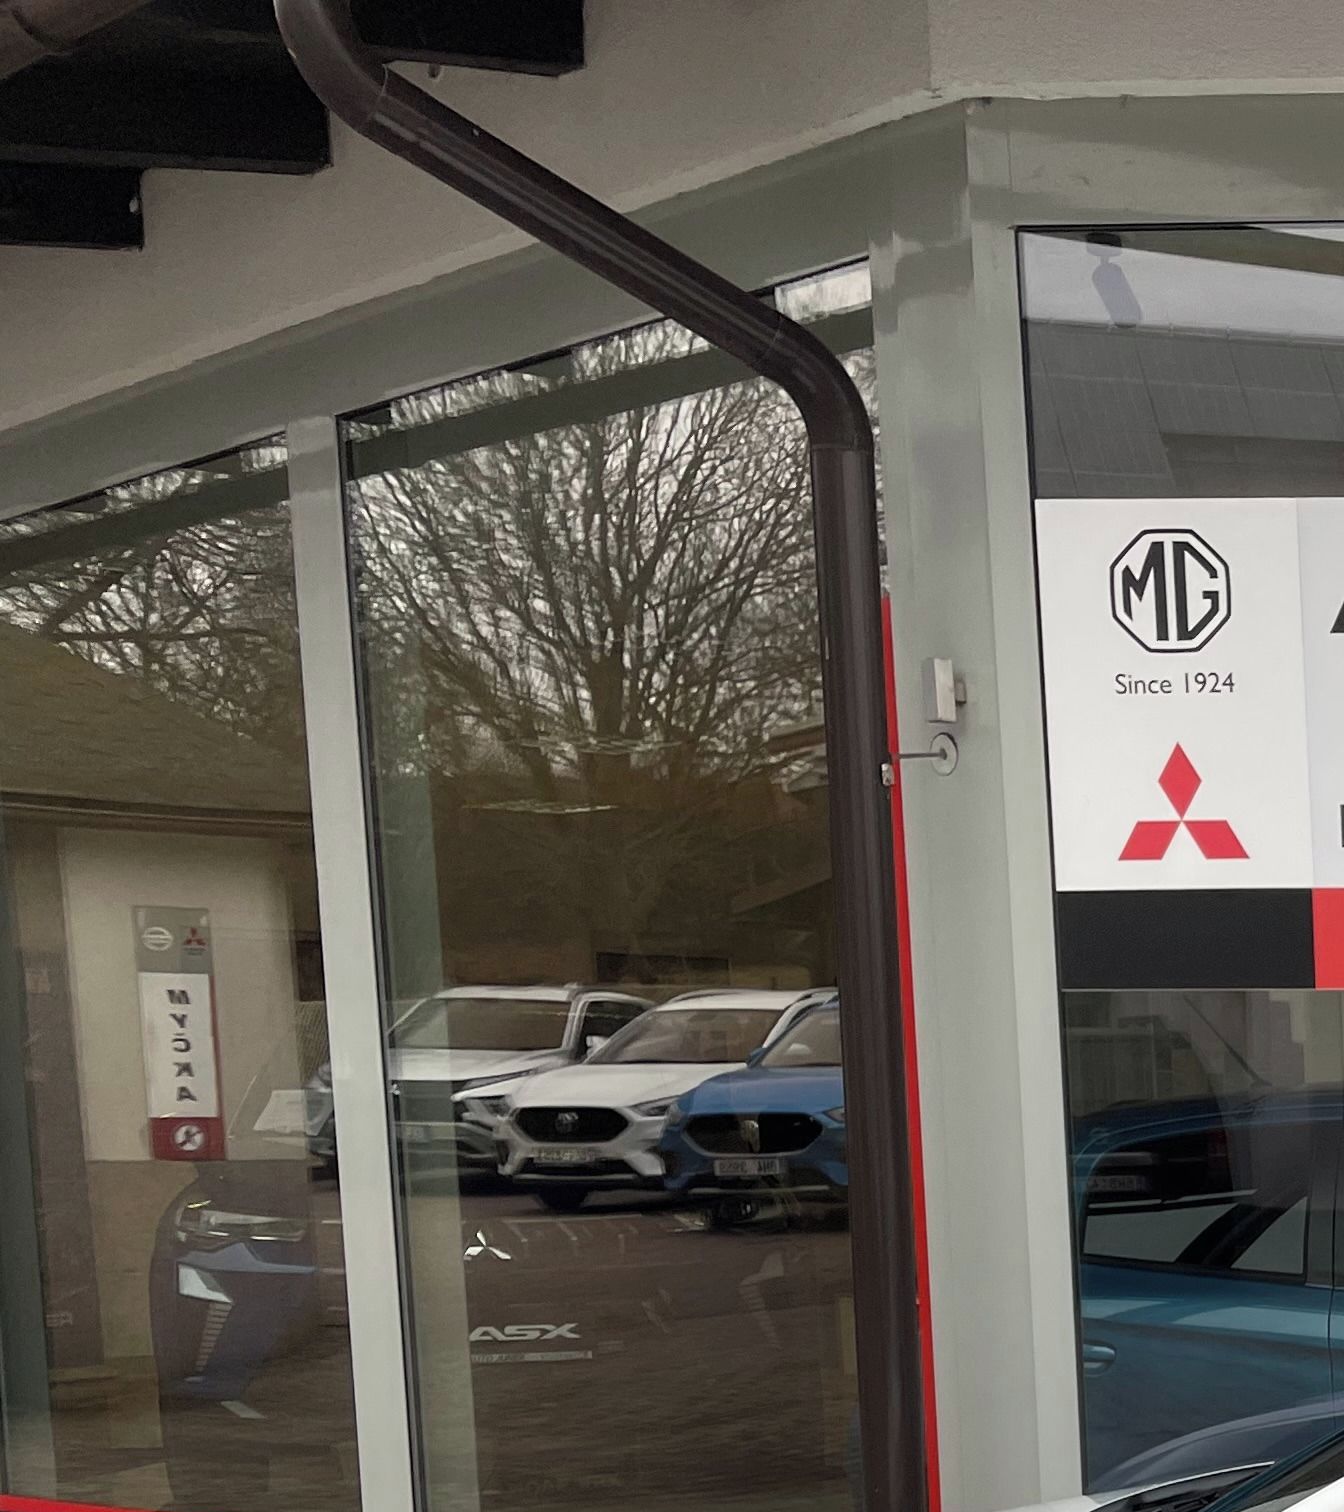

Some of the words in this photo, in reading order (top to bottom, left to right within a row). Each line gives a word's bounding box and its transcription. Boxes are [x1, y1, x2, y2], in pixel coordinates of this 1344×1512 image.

[1110, 529, 1232, 654] MG
[1115, 673, 1172, 695] Since
[1183, 672, 1235, 695] 1924
[468, 1322, 582, 1342] ASX
